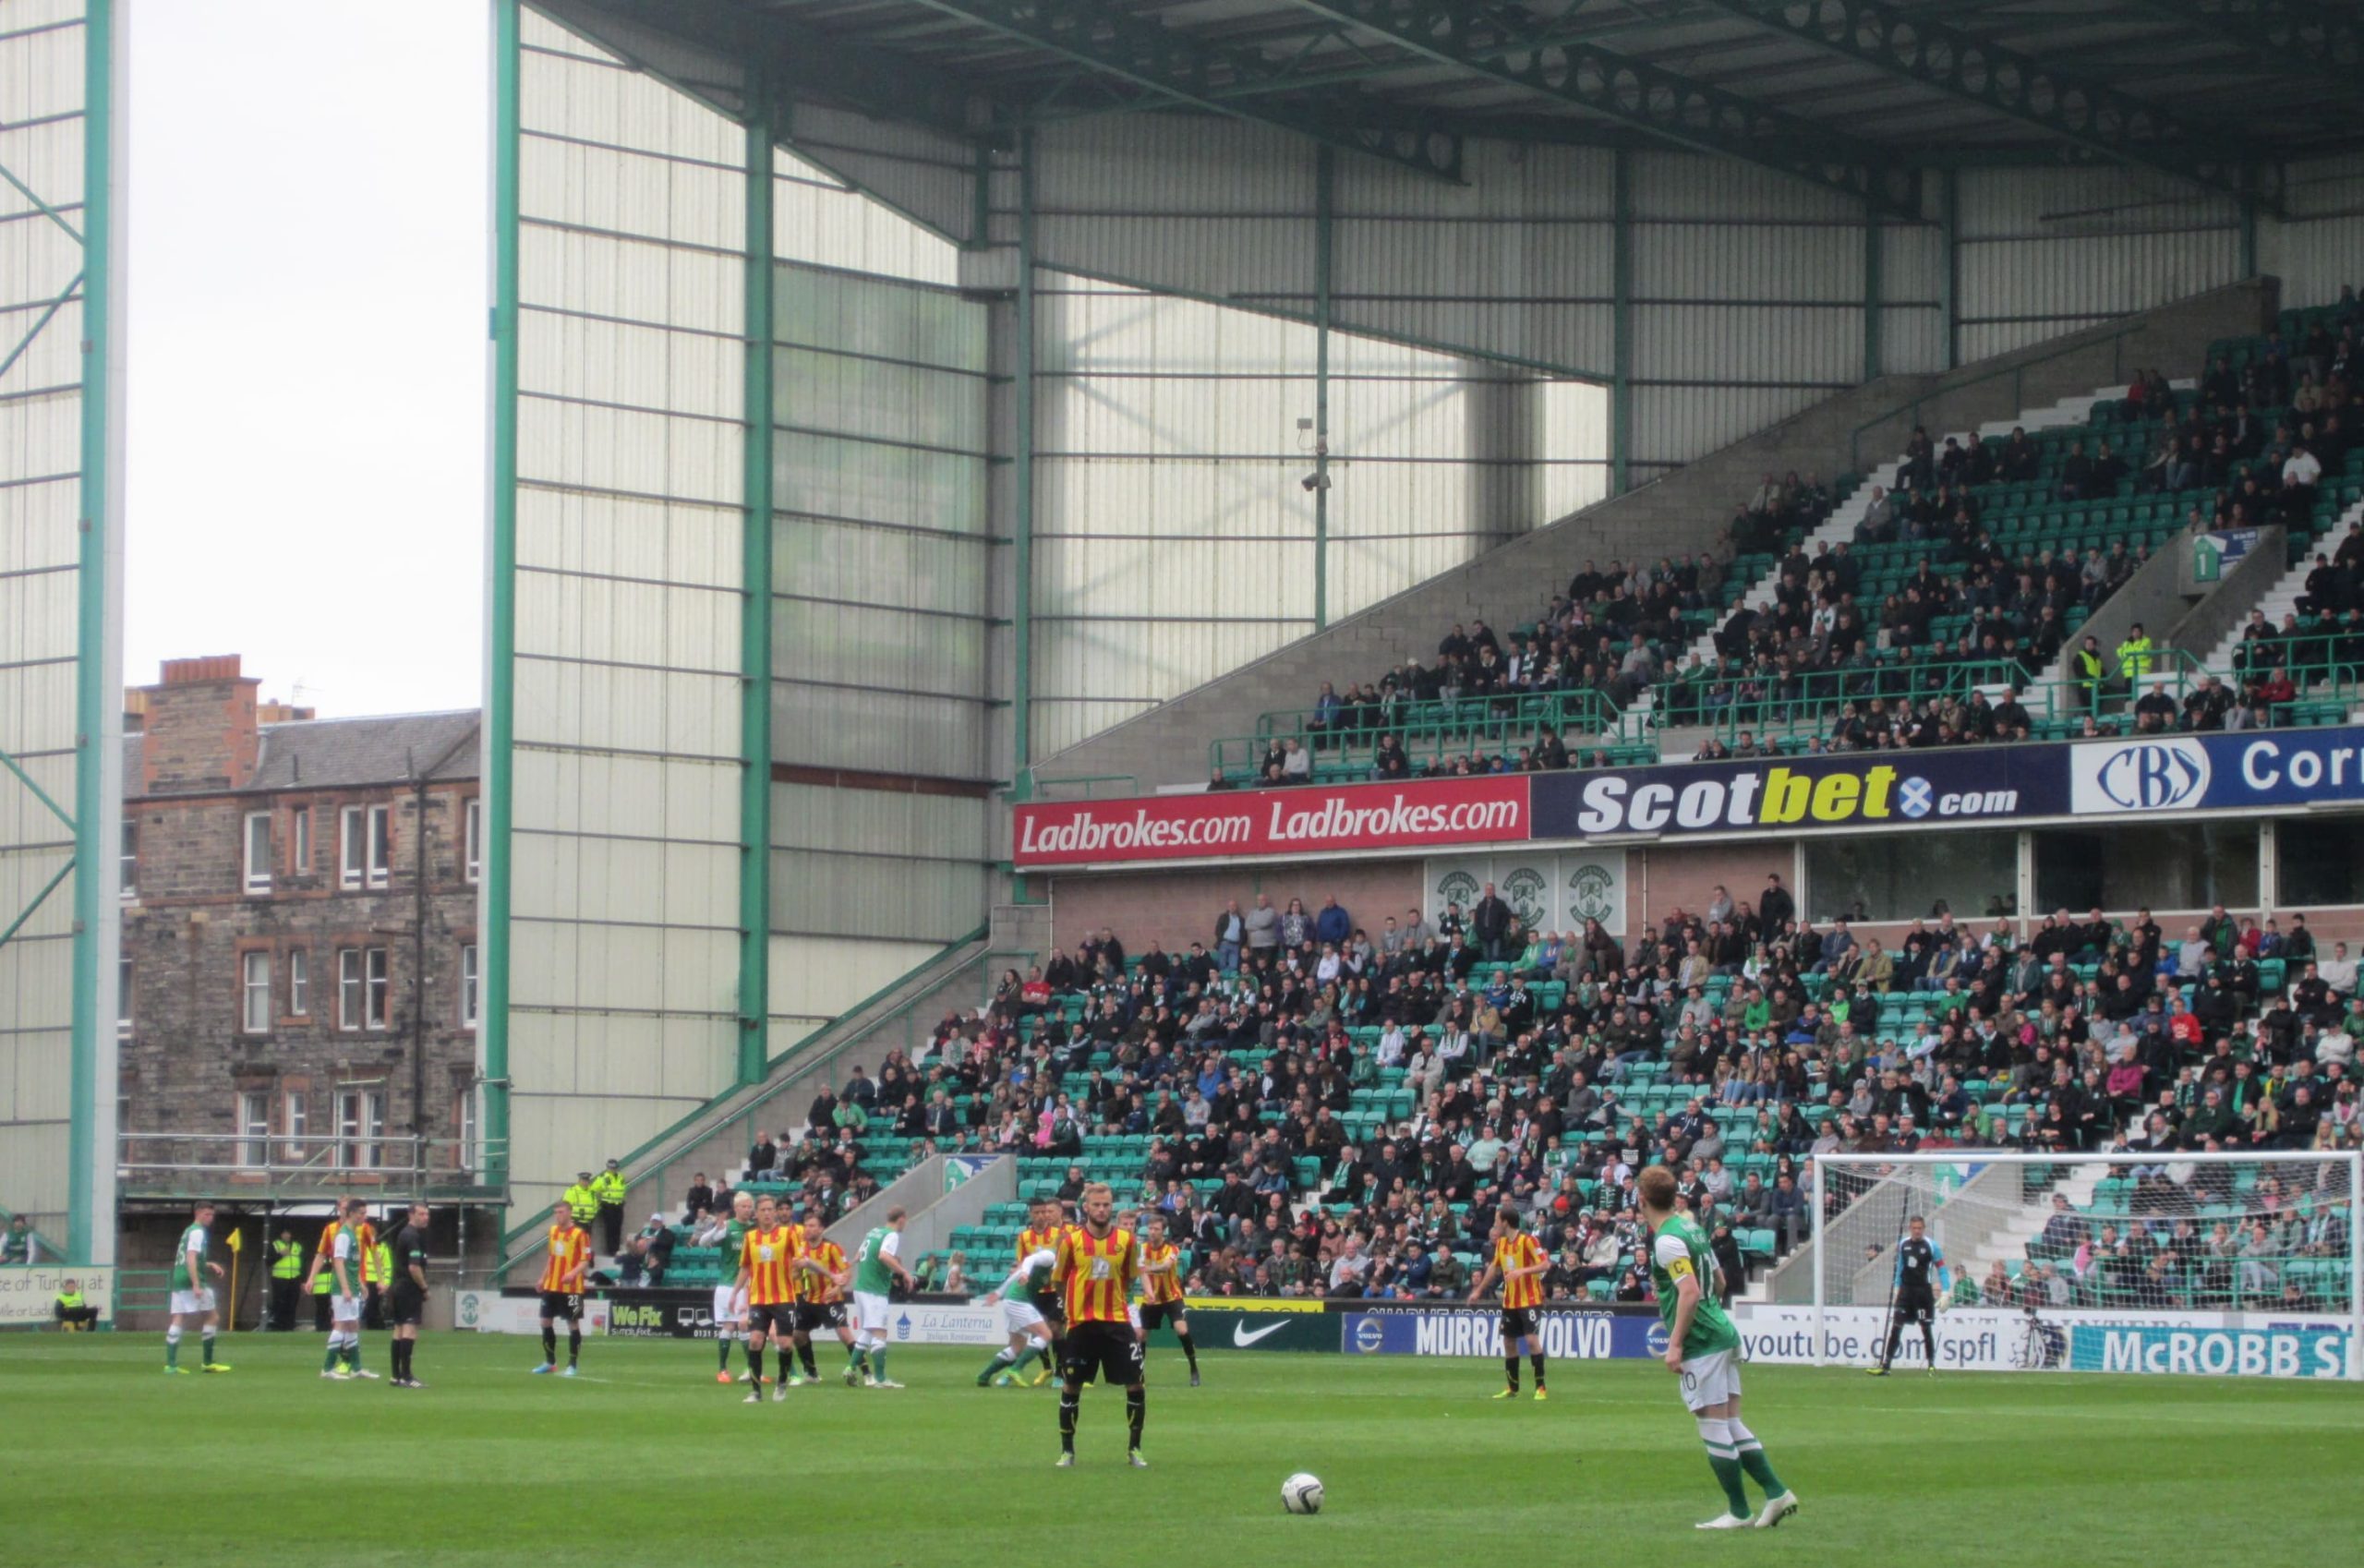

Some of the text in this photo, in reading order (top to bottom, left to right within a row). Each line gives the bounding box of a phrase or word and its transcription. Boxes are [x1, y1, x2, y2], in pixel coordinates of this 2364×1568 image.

[2097, 744, 2201, 790] CBS
[2242, 740, 2364, 790] Cor
[1268, 794, 1519, 841] Ladbrokes.com
[1577, 765, 1896, 833] Scotbet
[1020, 809, 1251, 854] Ladbrokes.com
[35, 1268, 85, 1296] Turky
[89, 1274, 103, 1290] at
[1673, 1260, 1684, 1274] C
[922, 1313, 993, 1330] La Lanterna
[1416, 1316, 1611, 1359] MURRA VOLVO
[1529, 1309, 1537, 1321] 8
[2103, 1331, 2355, 1380] McROBB S
